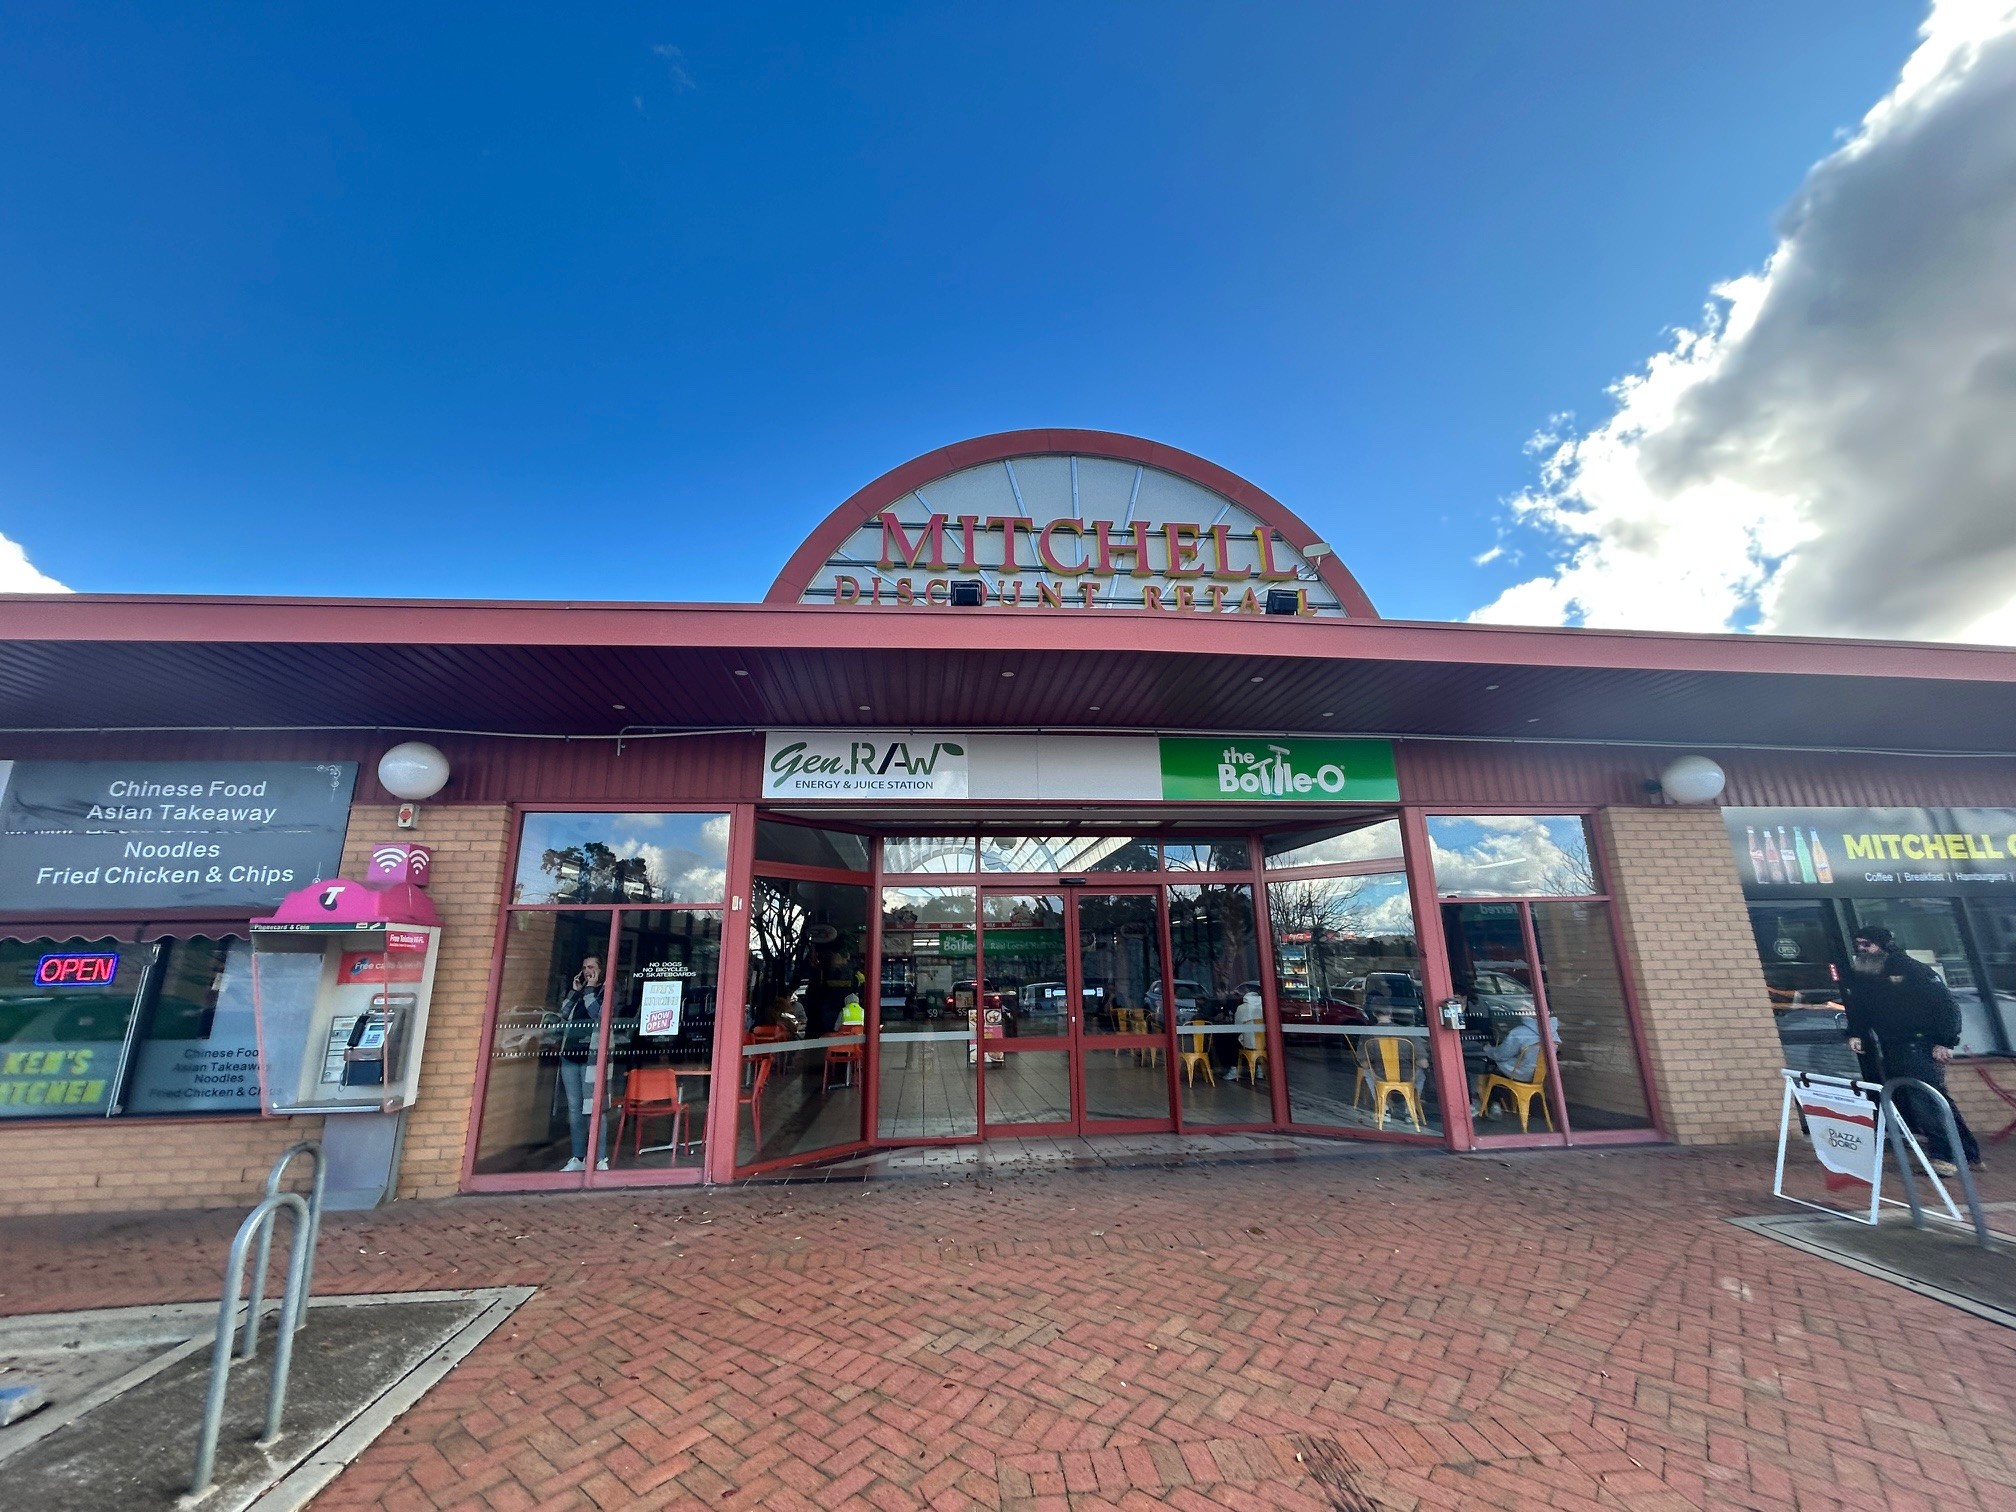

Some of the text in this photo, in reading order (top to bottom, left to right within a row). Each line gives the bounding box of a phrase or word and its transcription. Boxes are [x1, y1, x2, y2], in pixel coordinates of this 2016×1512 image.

[877, 512, 1298, 581] MITCHELL
[834, 575, 1318, 617] DISCUNT RETAL
[1223, 746, 1255, 764] the
[109, 780, 267, 798] Chinese Food
[795, 780, 934, 790] ENERGY & JUICE STATION
[86, 804, 277, 824] Asian Takeaway
[124, 841, 221, 859] Noodles
[1842, 833, 2005, 860] MITCHELL
[36, 865, 295, 886] Fried Chicken & Chips
[1864, 872, 1894, 882] Coffee
[1904, 872, 1945, 882] Breakfast
[40, 958, 114, 982] OPEN
[354, 961, 375, 970] Free
[651, 1010, 670, 1021] NOW
[646, 1019, 668, 1031] OPEN
[184, 1047, 262, 1059] Chinese Foo
[211, 1062, 271, 1073] Takeawy
[194, 1074, 244, 1084] Noodles
[0, 1079, 106, 1105] ITCHEN
[183, 1087, 234, 1098] Chicken
[236, 1087, 244, 1097] &
